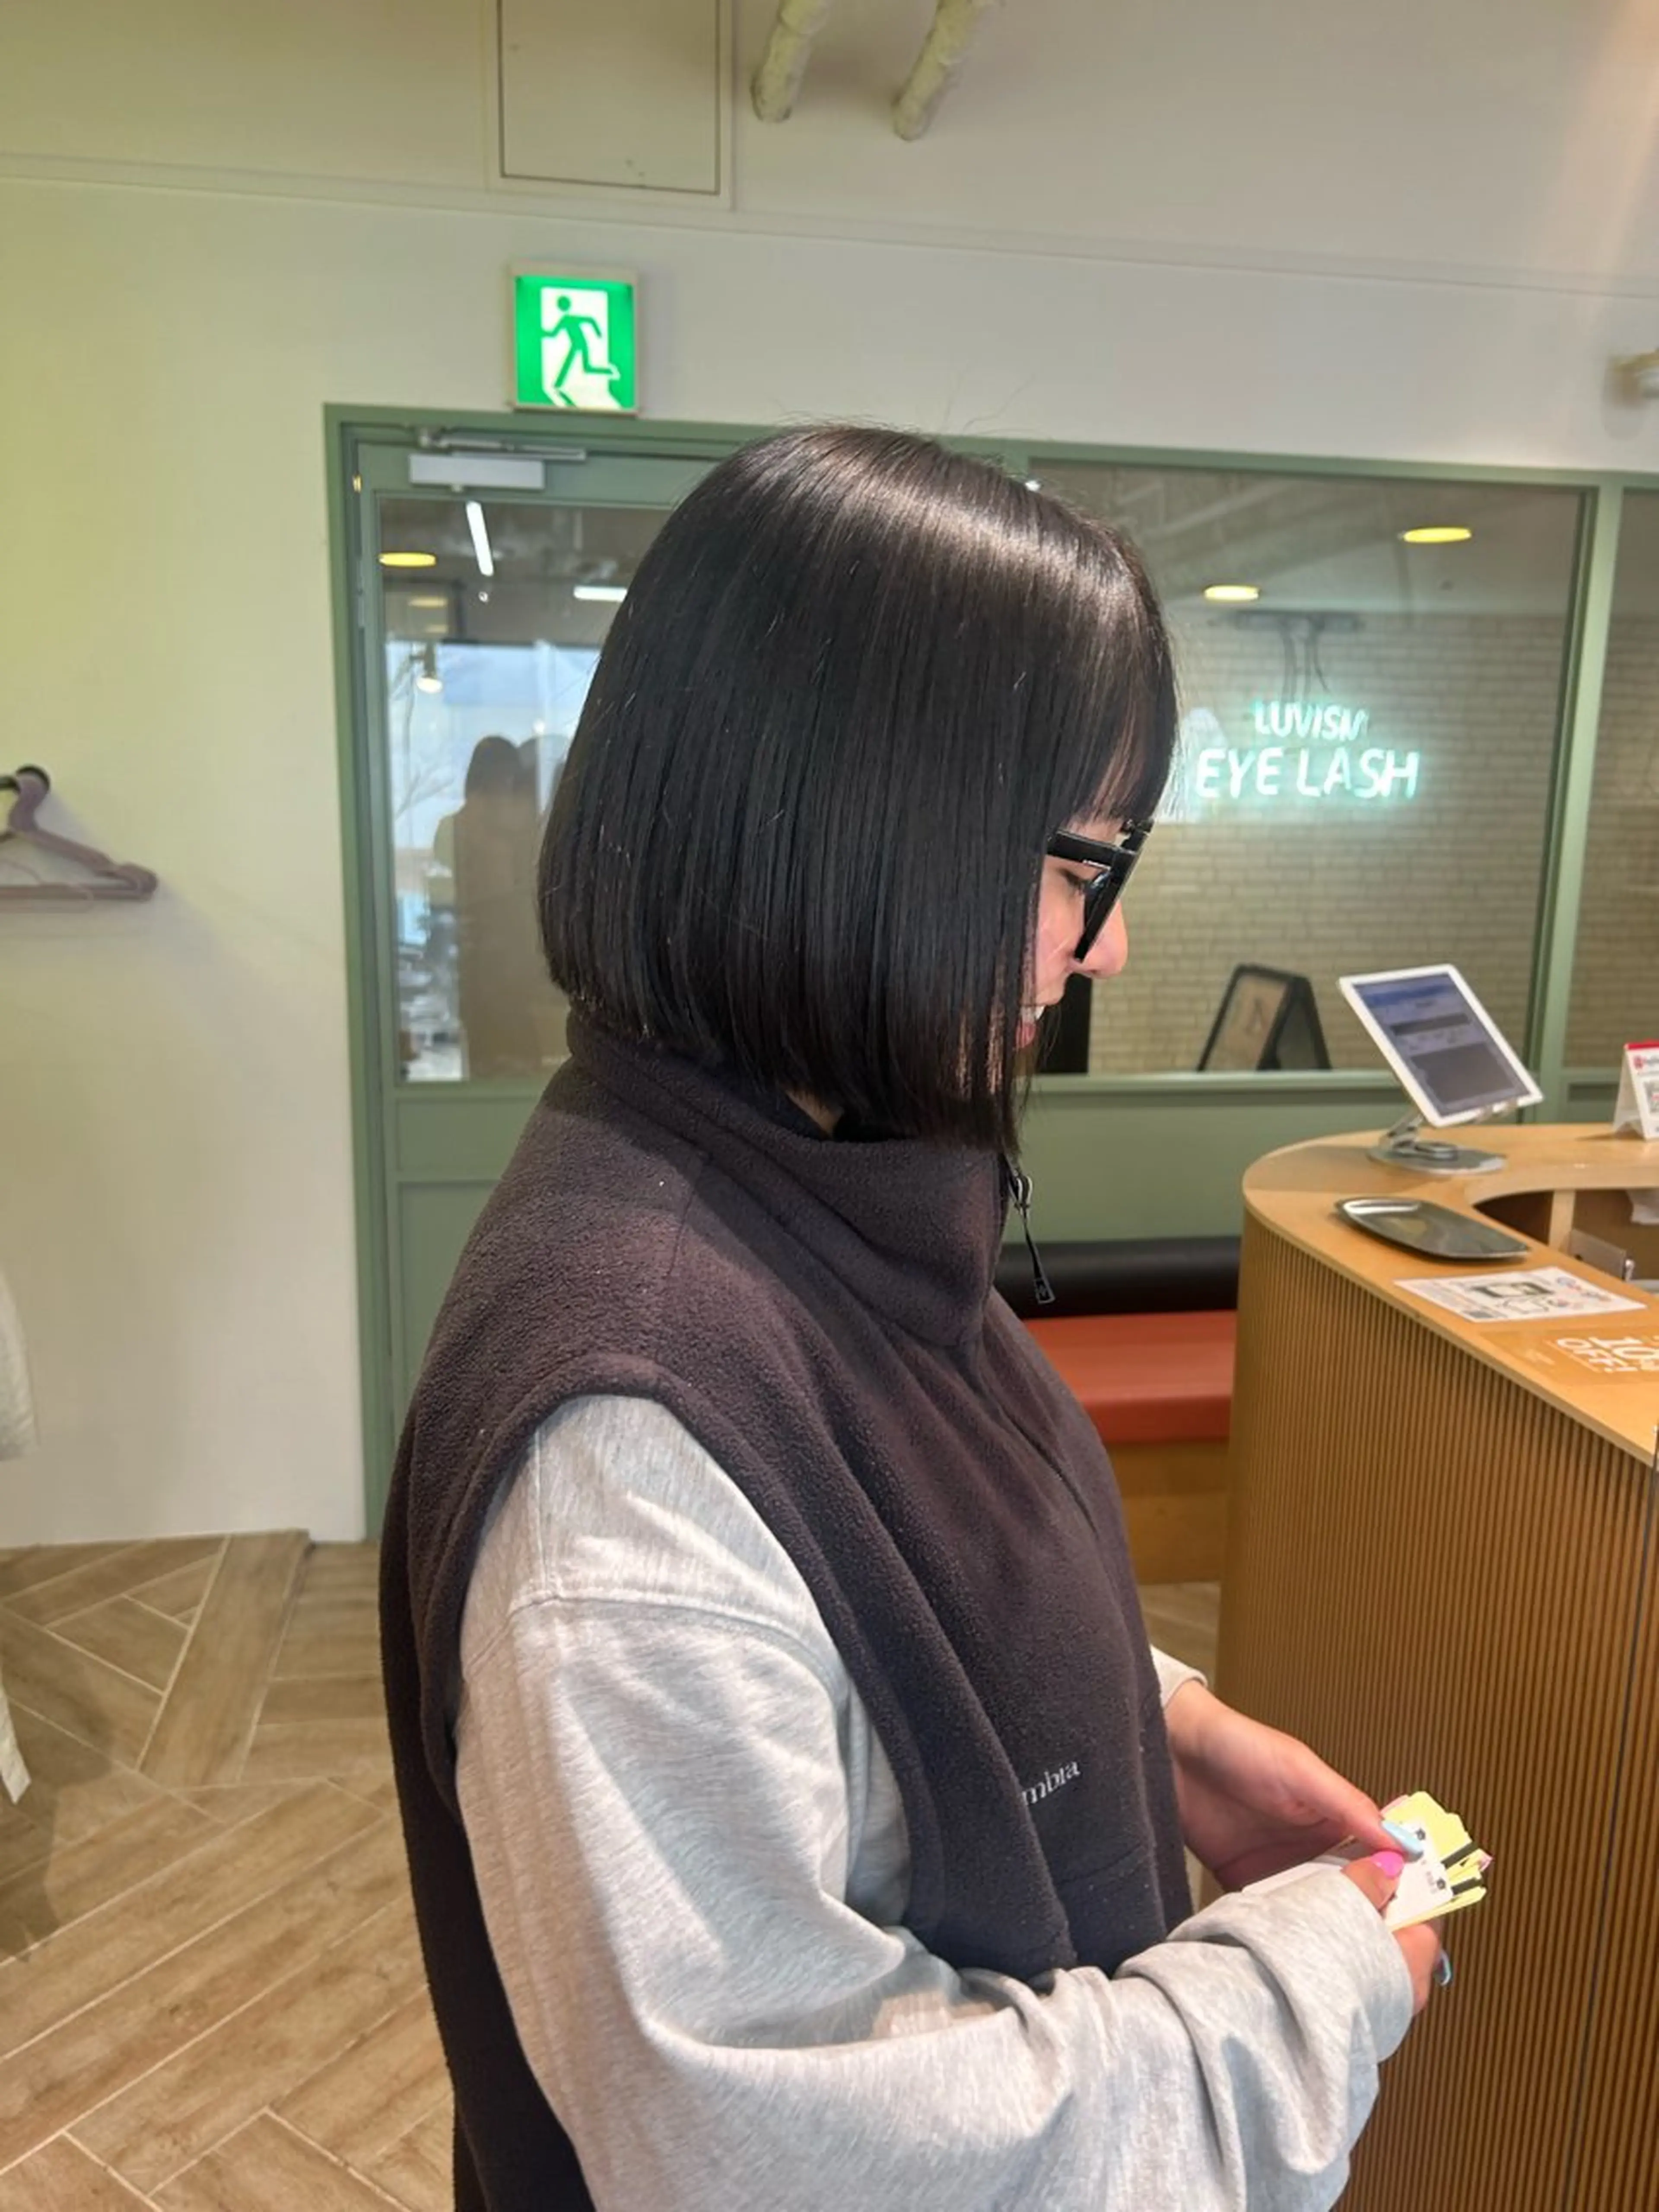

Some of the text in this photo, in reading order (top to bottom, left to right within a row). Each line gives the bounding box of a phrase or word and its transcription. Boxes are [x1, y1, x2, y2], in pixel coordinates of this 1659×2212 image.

[1254, 699, 1368, 741] LUVISM
[1195, 746, 1421, 799] EYE LASH
[1556, 1338, 1638, 1373] OFF!
